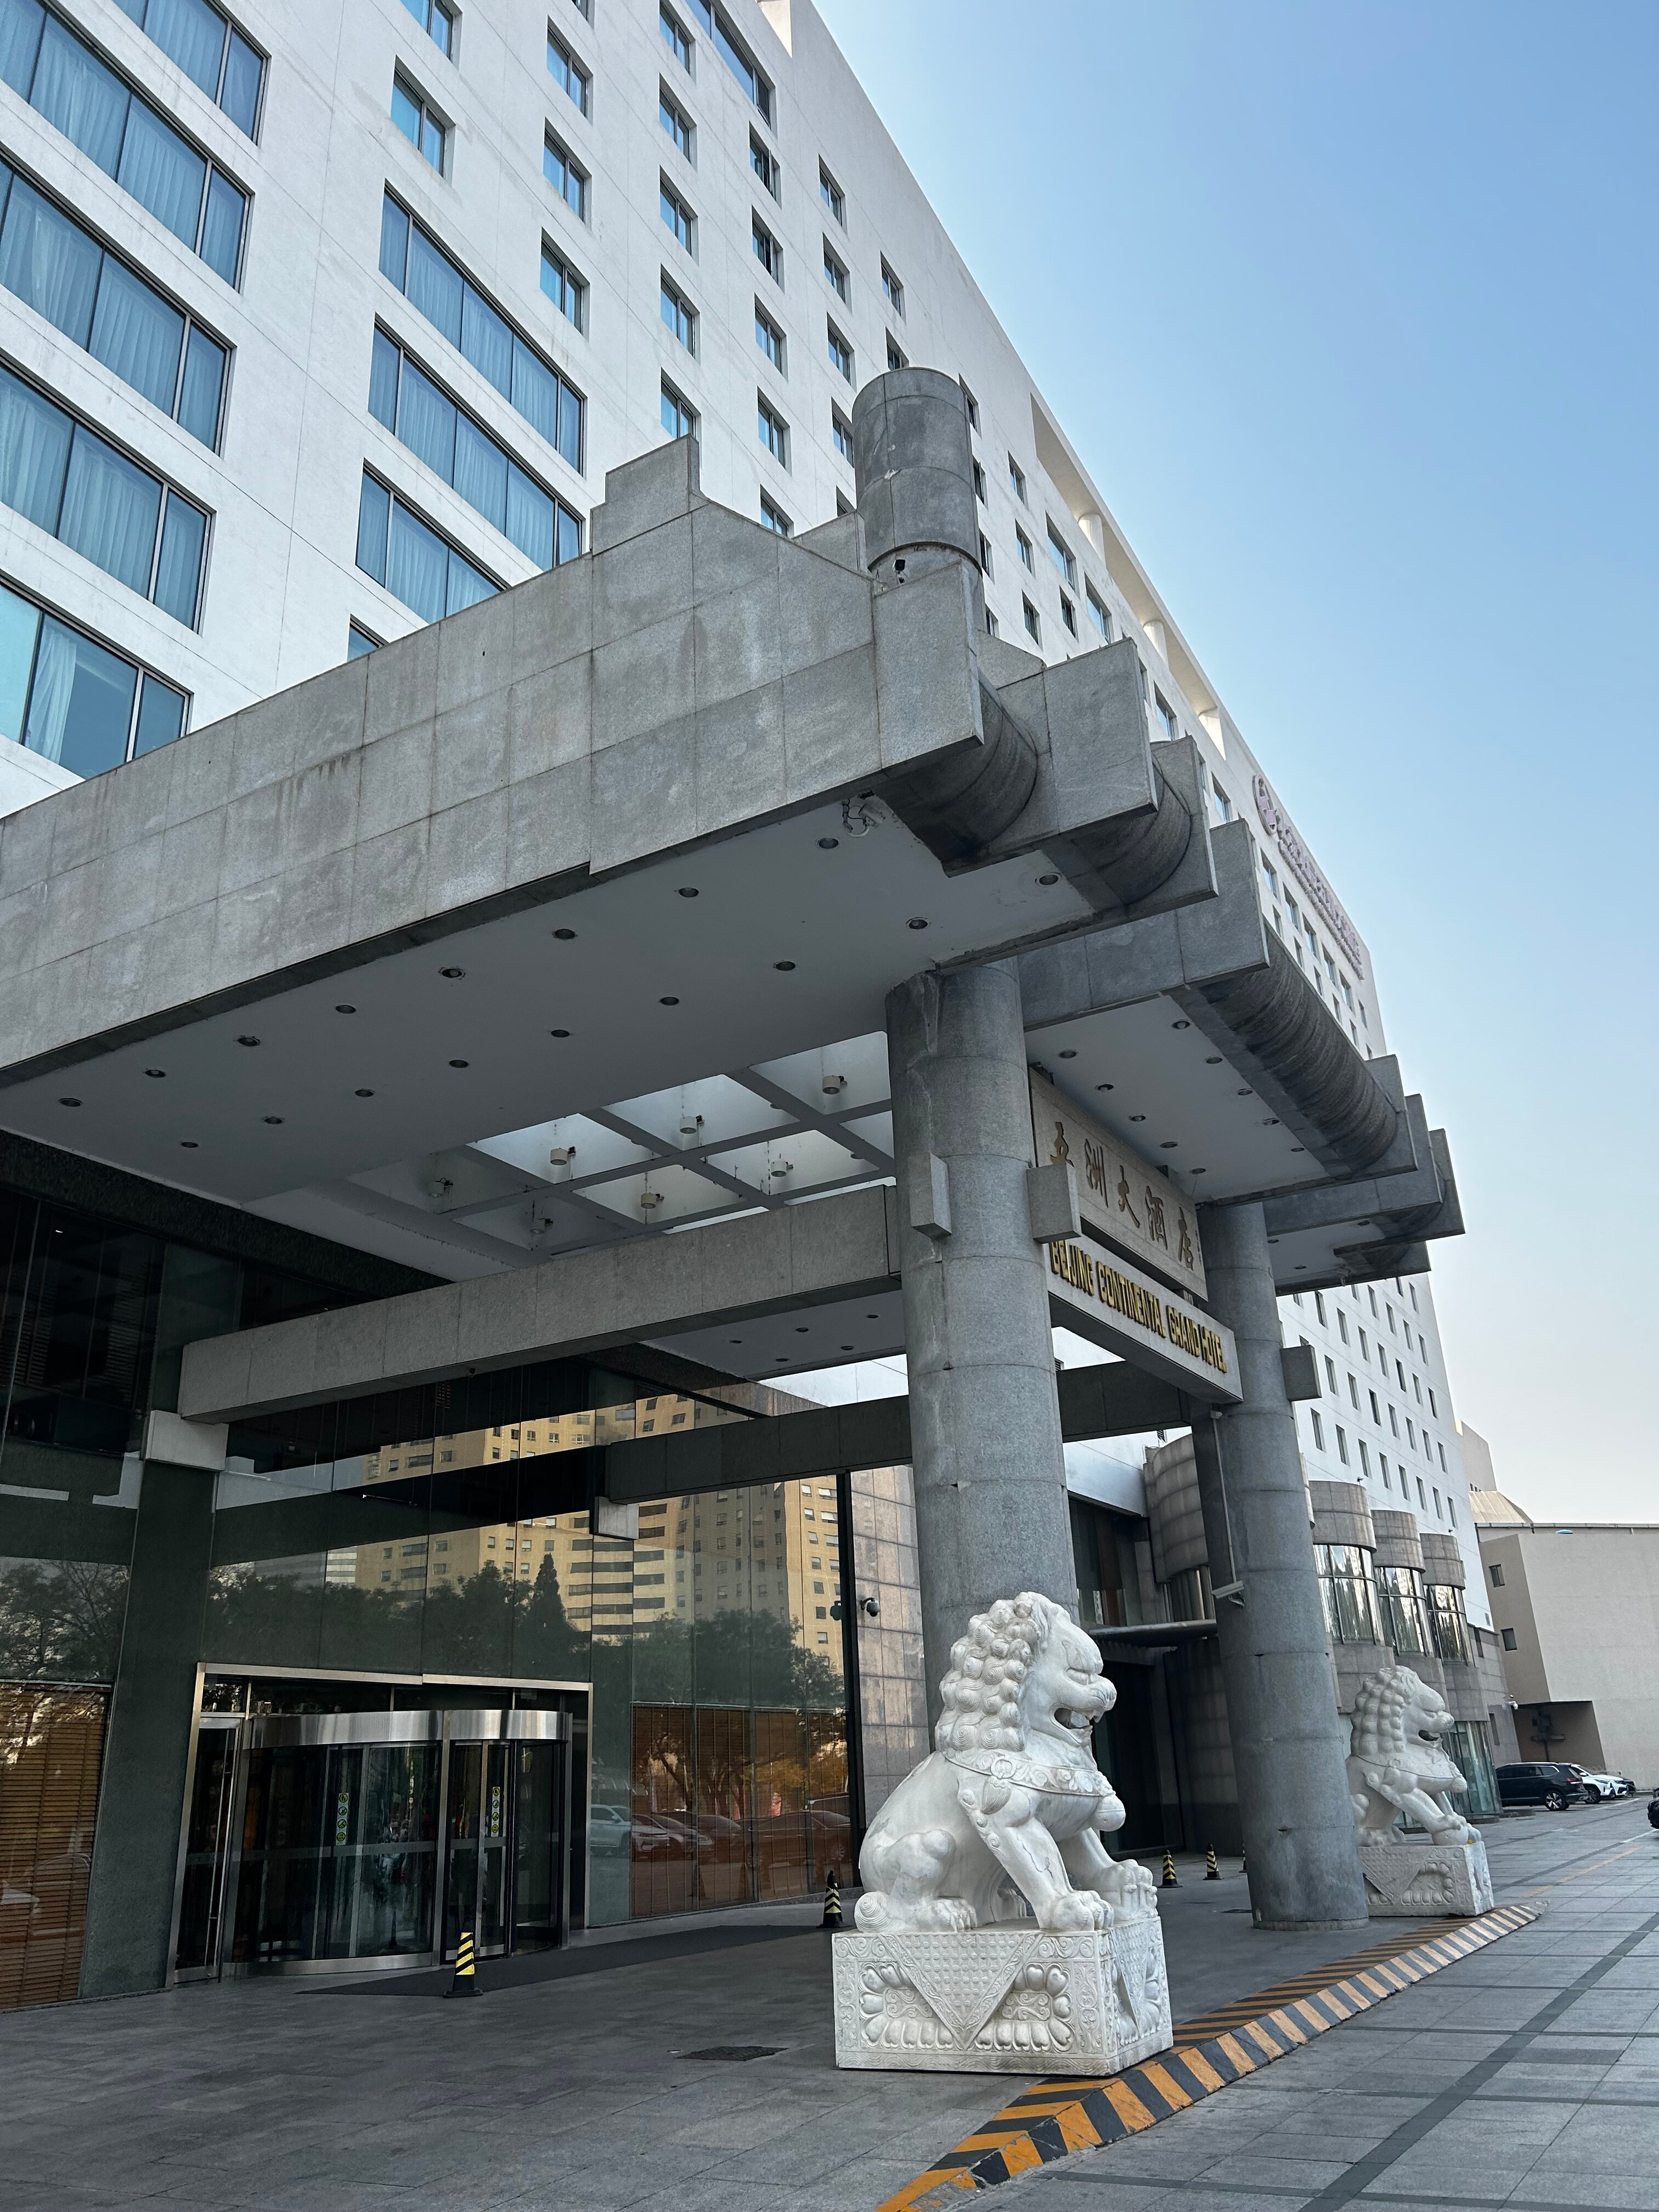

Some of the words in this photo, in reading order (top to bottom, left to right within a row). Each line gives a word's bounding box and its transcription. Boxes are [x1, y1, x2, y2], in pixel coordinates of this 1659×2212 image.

[1049, 1239, 1094, 1296] BEIJING
[1166, 1305, 1200, 1357] GRAND
[1198, 1324, 1227, 1374] HOTEL
